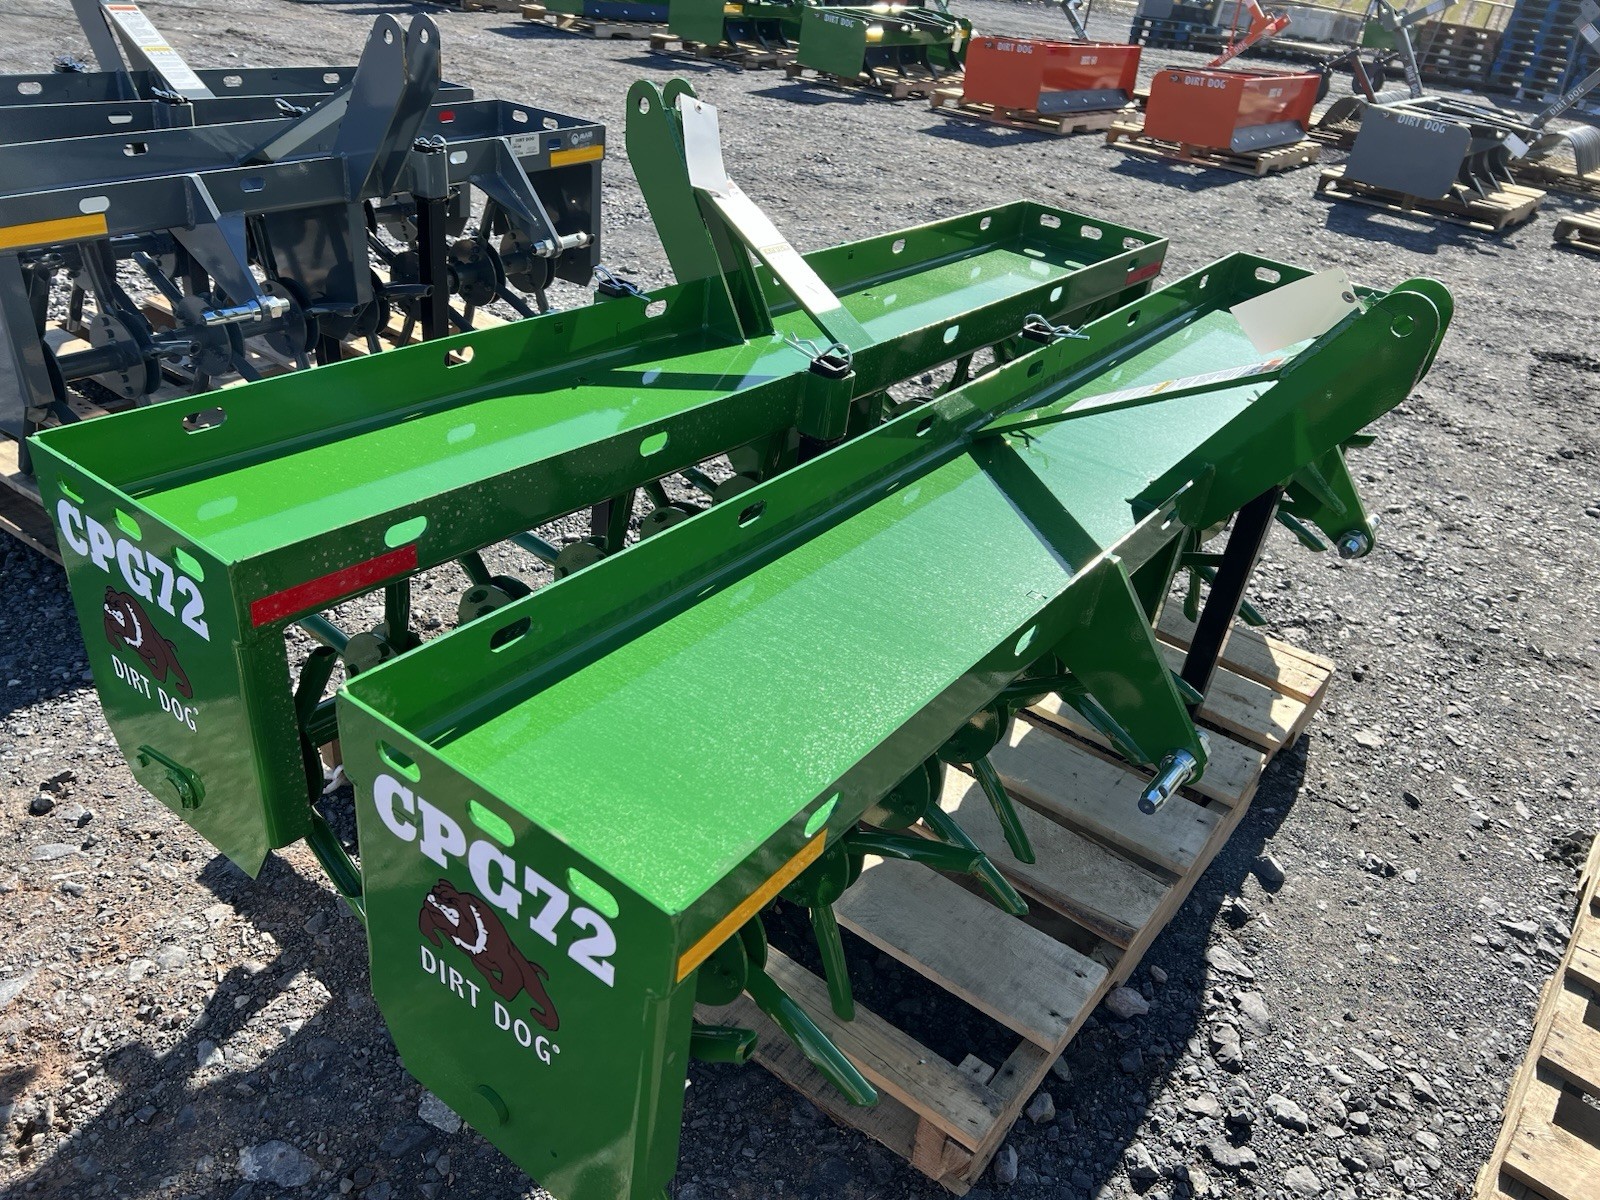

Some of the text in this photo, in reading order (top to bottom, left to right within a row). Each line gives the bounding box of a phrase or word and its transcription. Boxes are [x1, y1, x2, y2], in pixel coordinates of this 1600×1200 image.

[1184, 76, 1226, 89] DIRT DOG
[1549, 85, 1585, 116] DIRT DOG
[1397, 115, 1447, 134] DIRT DOG
[57, 499, 210, 642] CPG72
[111, 653, 152, 699] DIRT
[373, 773, 616, 988] CPG72
[420, 945, 481, 1009] DIRT
